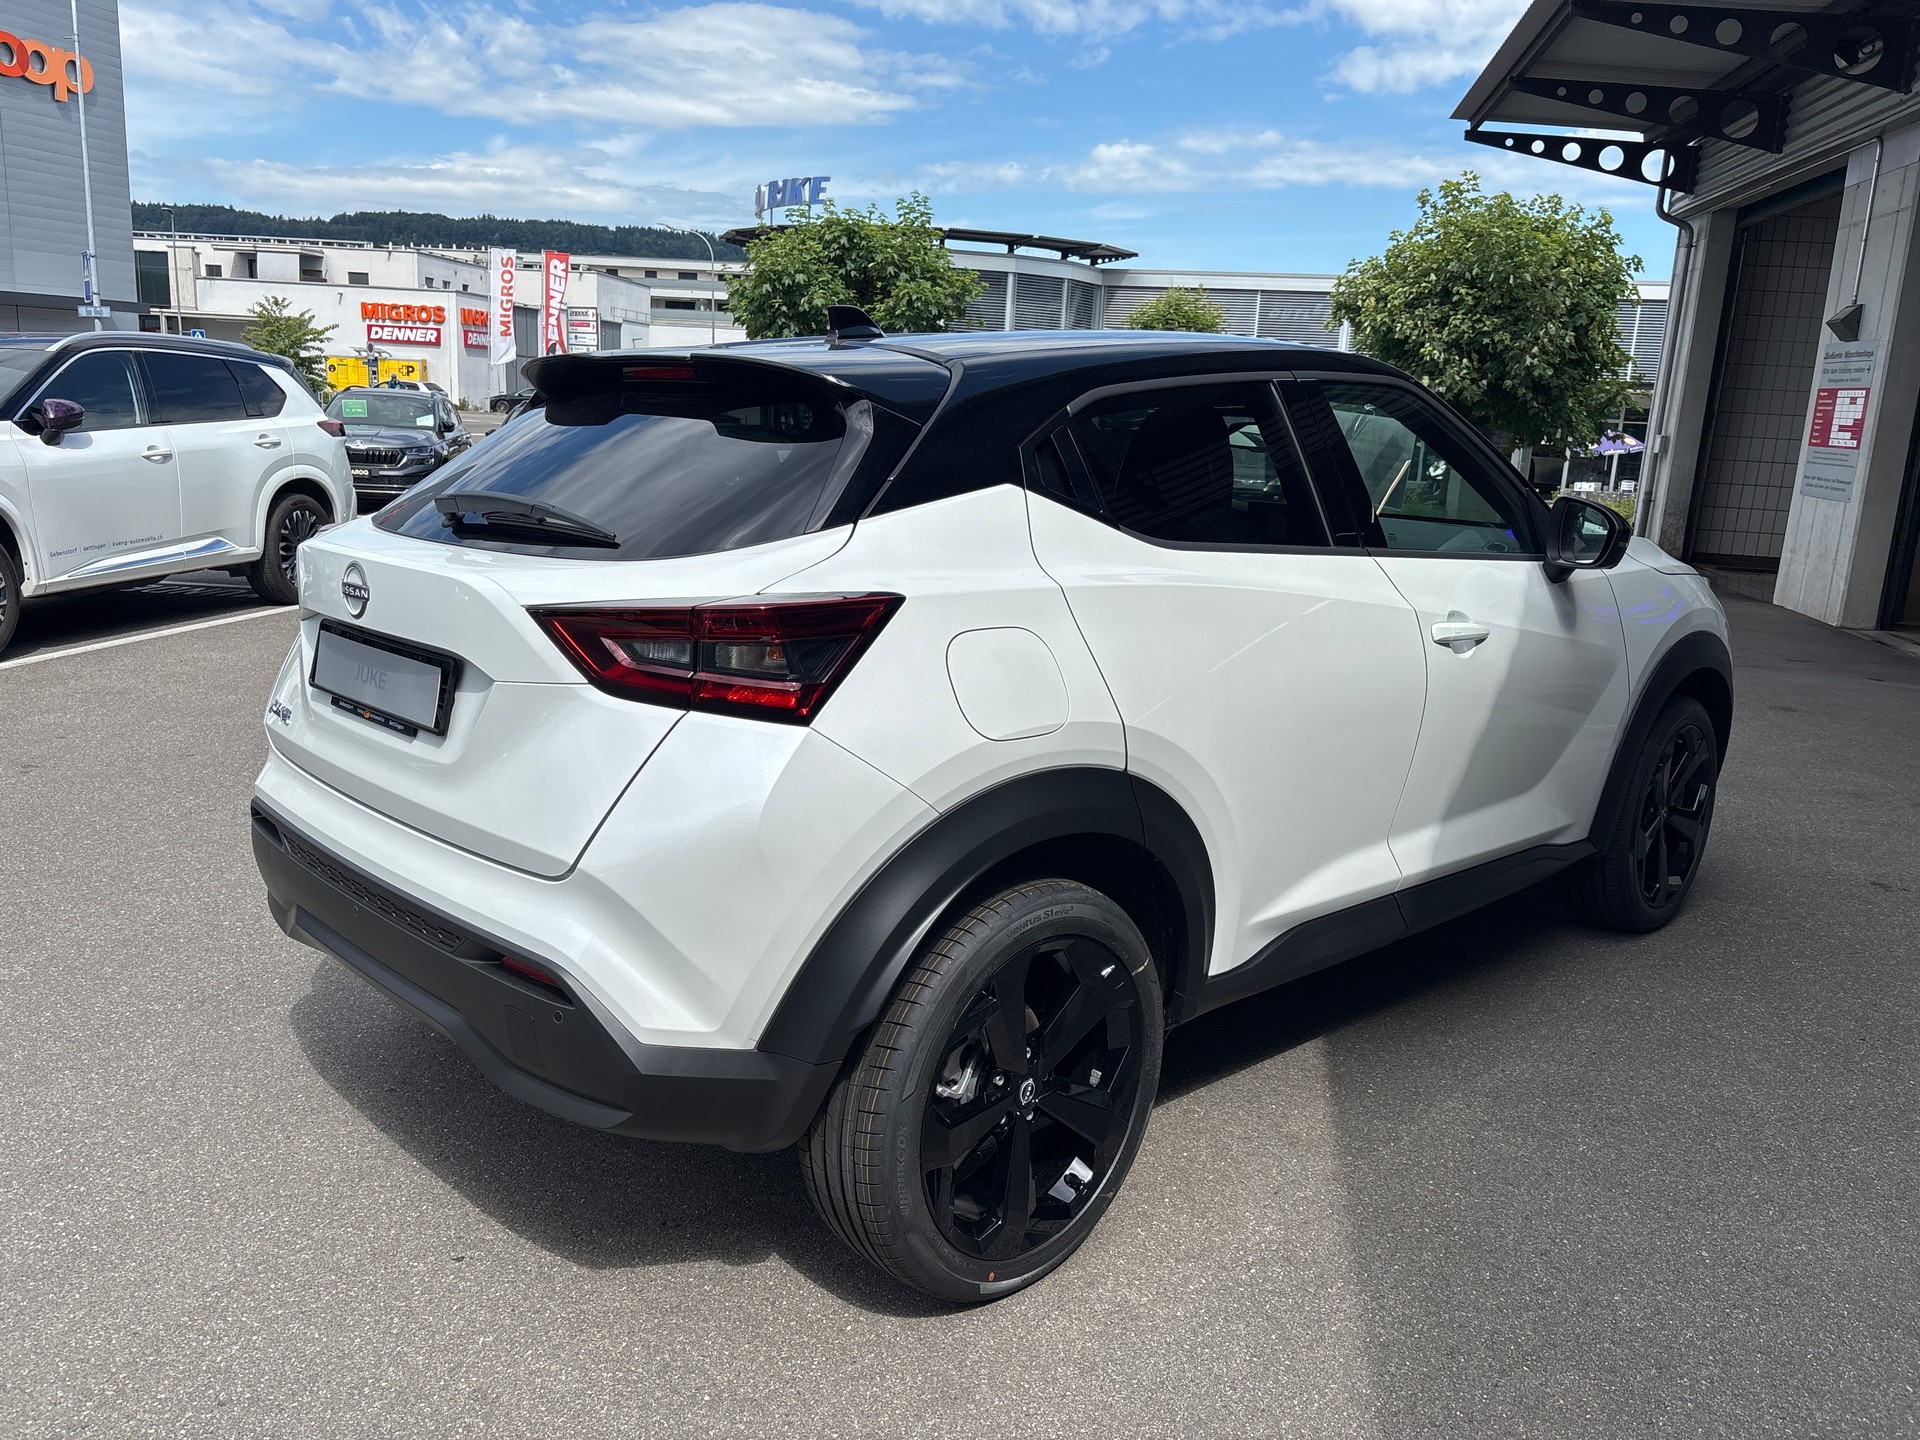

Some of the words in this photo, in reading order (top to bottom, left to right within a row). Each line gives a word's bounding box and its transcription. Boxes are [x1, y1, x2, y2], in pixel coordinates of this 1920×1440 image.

[0, 30, 94, 102] oop
[500, 256, 514, 337] MIGROS
[361, 302, 446, 323] MIGROS
[461, 308, 488, 326] MIGR
[370, 326, 438, 342] DENNER
[50, 546, 78, 558] Gebenstorf
[83, 543, 107, 552] Wettingen
[112, 534, 163, 547] kueng-automobile.ch
[344, 585, 368, 598] SSAN
[354, 665, 388, 691] JUKE
